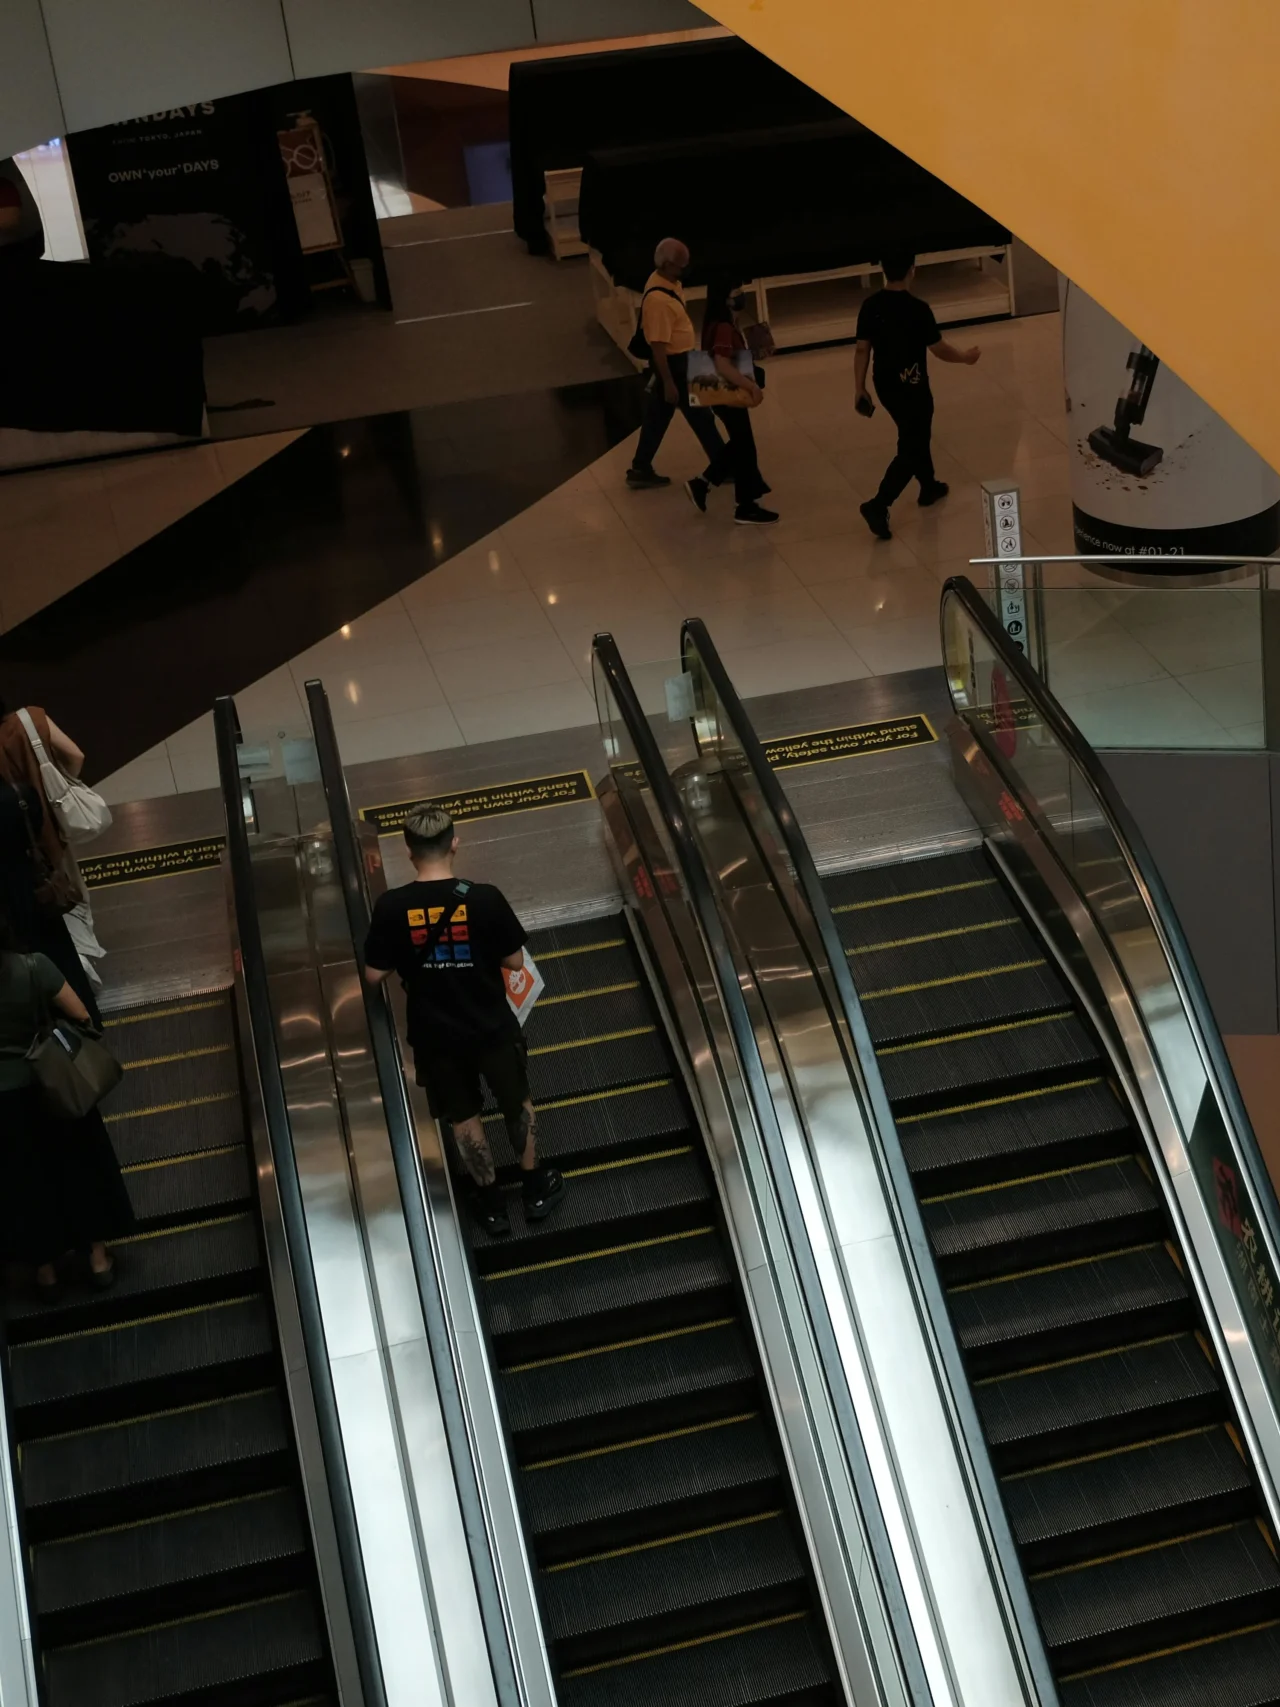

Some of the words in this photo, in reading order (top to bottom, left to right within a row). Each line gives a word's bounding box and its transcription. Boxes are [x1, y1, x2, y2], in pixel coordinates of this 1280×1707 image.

[112, 100, 216, 126] DAYS
[1102, 540, 1123, 553] now
[880, 724, 918, 735] stand
[836, 731, 878, 743] within
[862, 735, 893, 746] your
[896, 731, 919, 740] For
[812, 737, 834, 747] the
[830, 741, 859, 751] own
[538, 780, 578, 794] stand
[562, 788, 577, 796] For
[492, 787, 535, 801] within
[517, 791, 549, 804] your
[465, 796, 488, 805] the
[484, 799, 513, 810] own
[184, 843, 225, 857] stand
[135, 852, 180, 864] within
[160, 855, 194, 868] your
[106, 860, 130, 869] the
[124, 864, 156, 874] own
